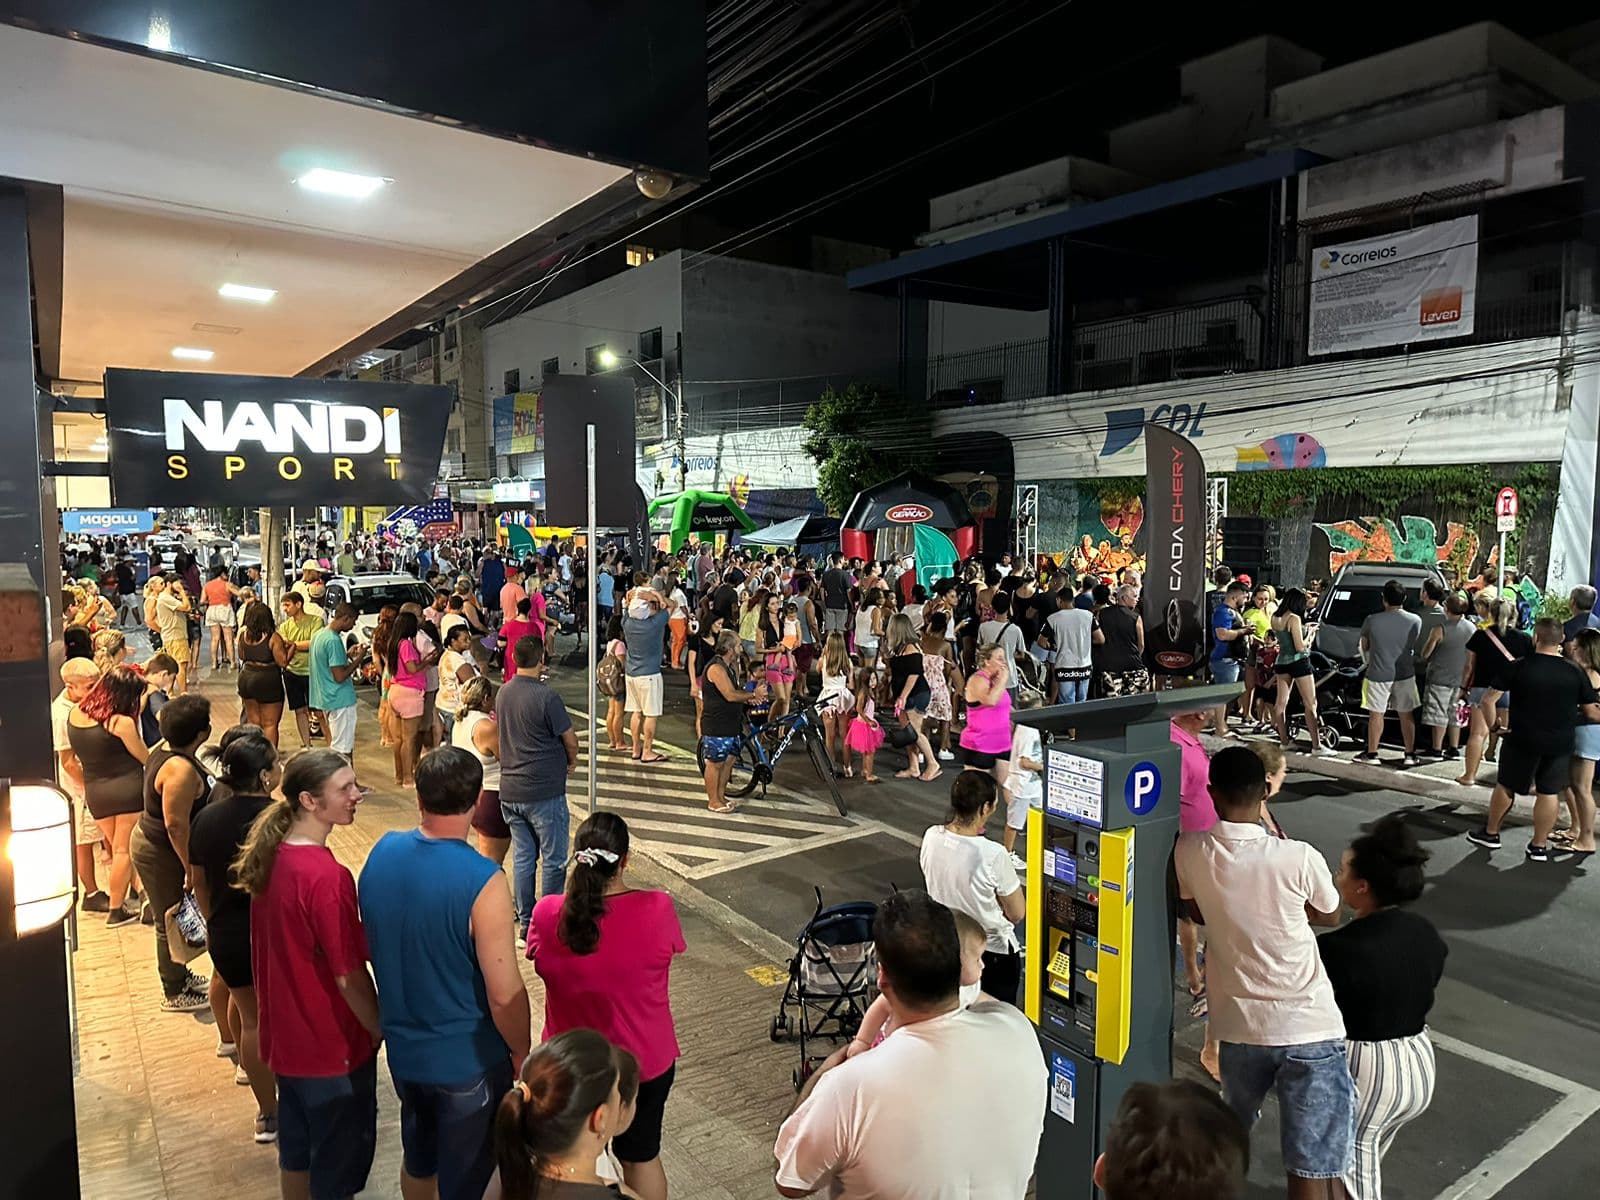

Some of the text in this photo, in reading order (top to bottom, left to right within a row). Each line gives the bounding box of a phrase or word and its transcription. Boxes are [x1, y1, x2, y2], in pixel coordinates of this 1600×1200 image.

[1341, 246, 1397, 265] Correios
[163, 398, 401, 454] NANDI
[1150, 402, 1207, 437] CDL
[167, 455, 401, 480] SPORT
[685, 456, 718, 471] orreios
[1172, 446, 1184, 523] CHERY
[1134, 770, 1154, 809] P
